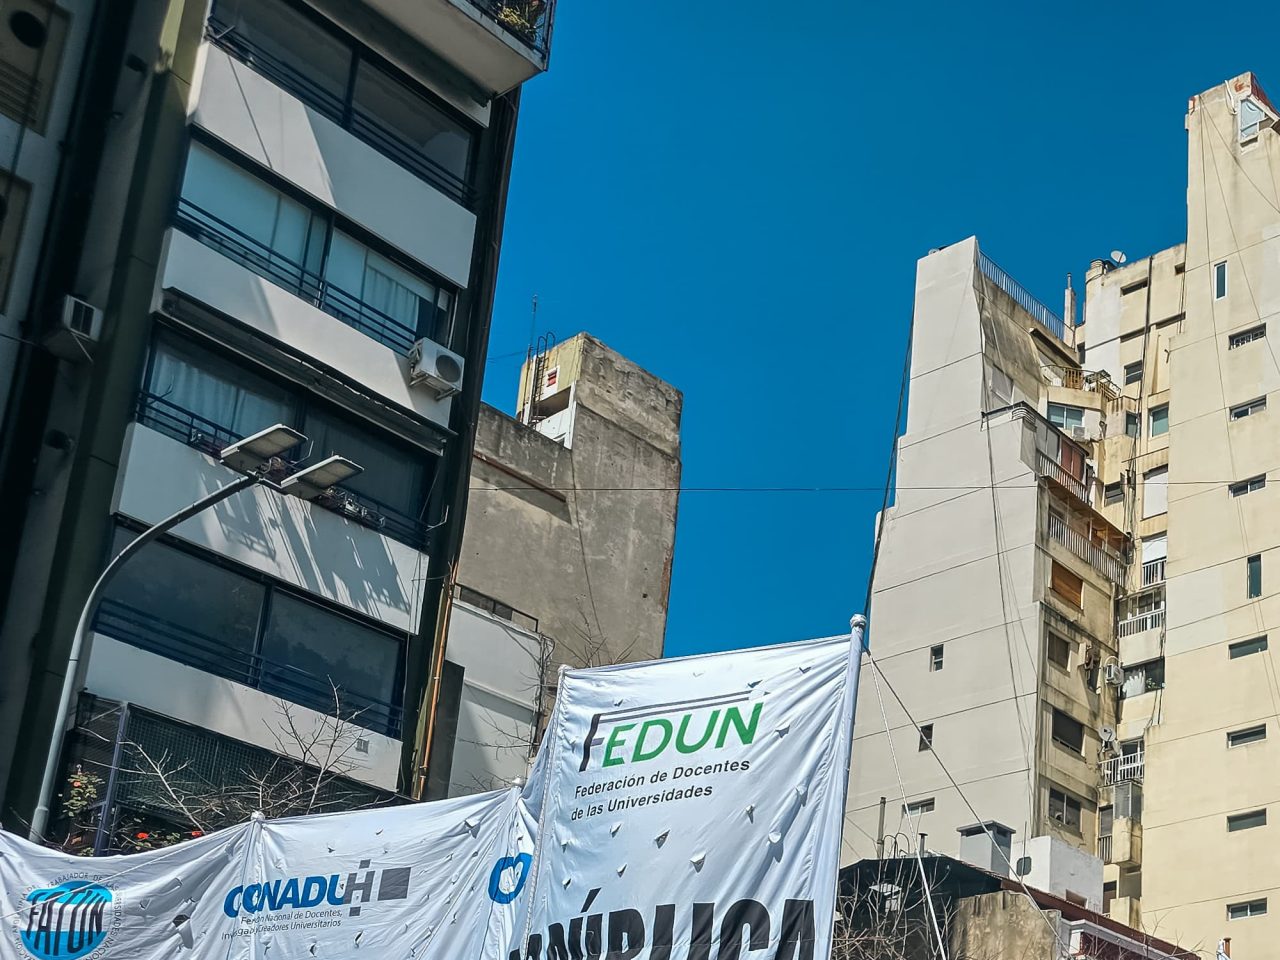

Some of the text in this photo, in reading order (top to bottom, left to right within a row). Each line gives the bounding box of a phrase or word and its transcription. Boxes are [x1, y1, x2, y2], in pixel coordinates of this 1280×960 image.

[579, 701, 764, 773] FEDUN
[574, 760, 751, 800] Federación de Docentes
[571, 785, 713, 821] de las Universidades
[25, 888, 108, 956] FATUN
[290, 919, 342, 930] Universitarios
